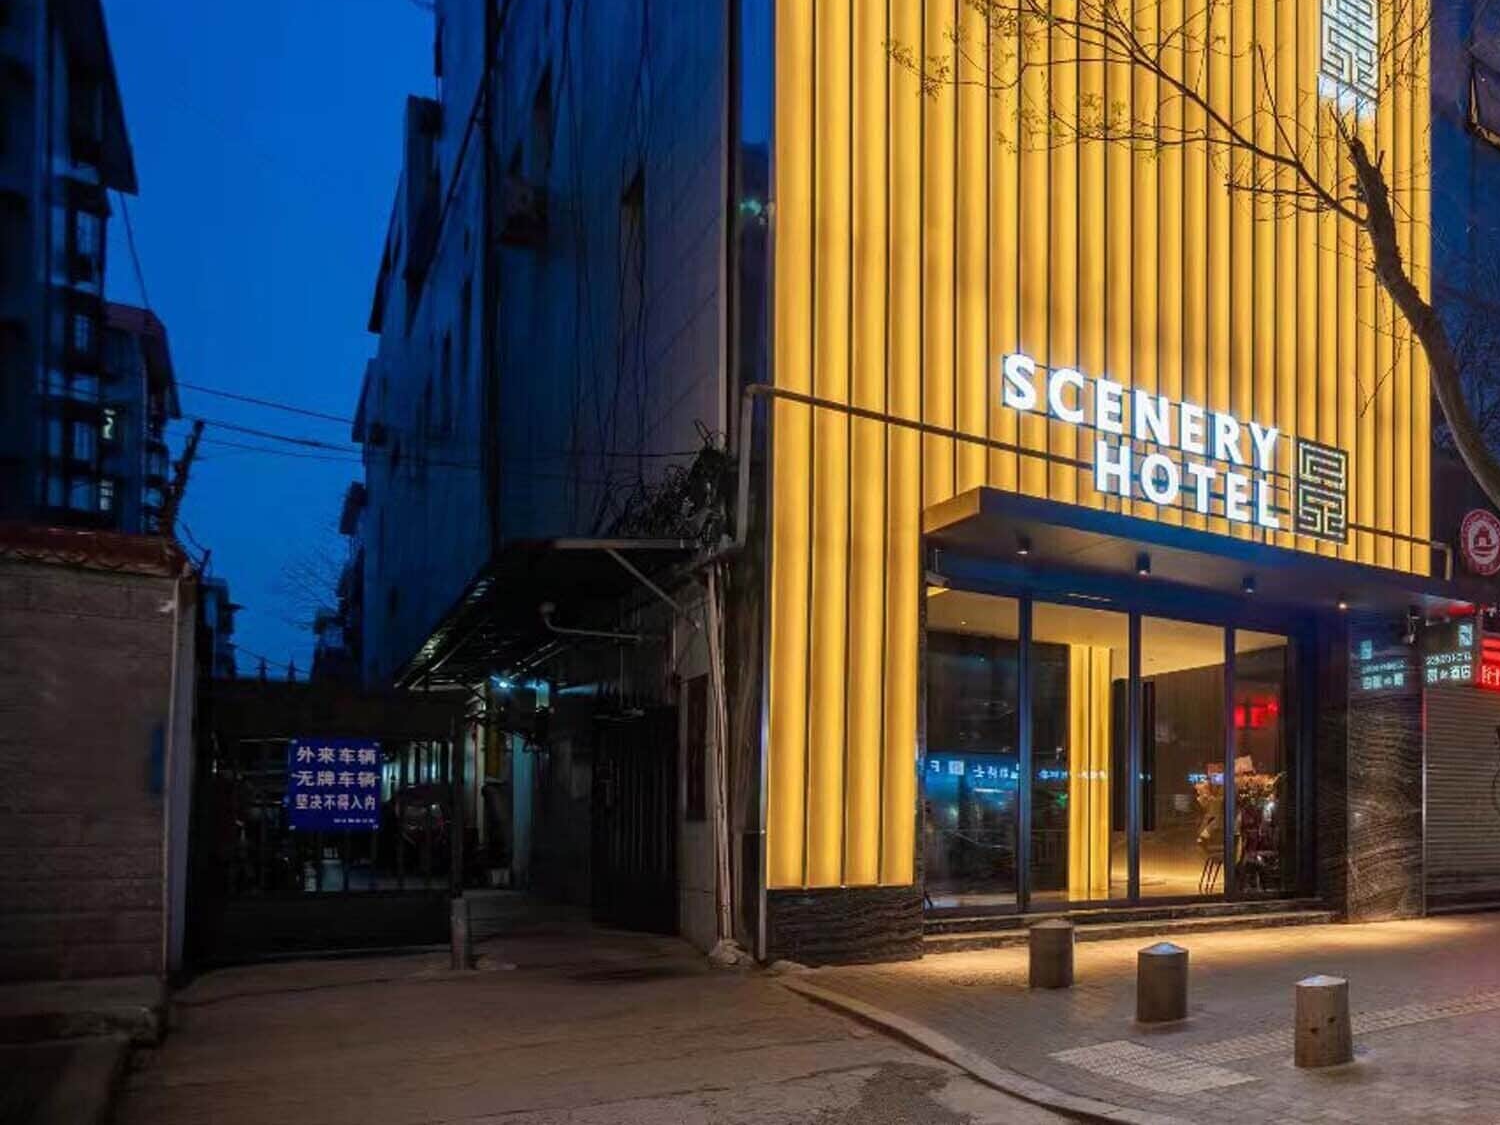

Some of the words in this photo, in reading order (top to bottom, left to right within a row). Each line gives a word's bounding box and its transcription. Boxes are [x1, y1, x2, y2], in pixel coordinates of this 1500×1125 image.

[1003, 353, 1280, 473] SCENERY
[1097, 438, 1281, 529] HOTEL
[297, 746, 376, 765] 外来车辆
[297, 770, 376, 788] 无牌车辆
[296, 793, 376, 811] 坚决不得入内
